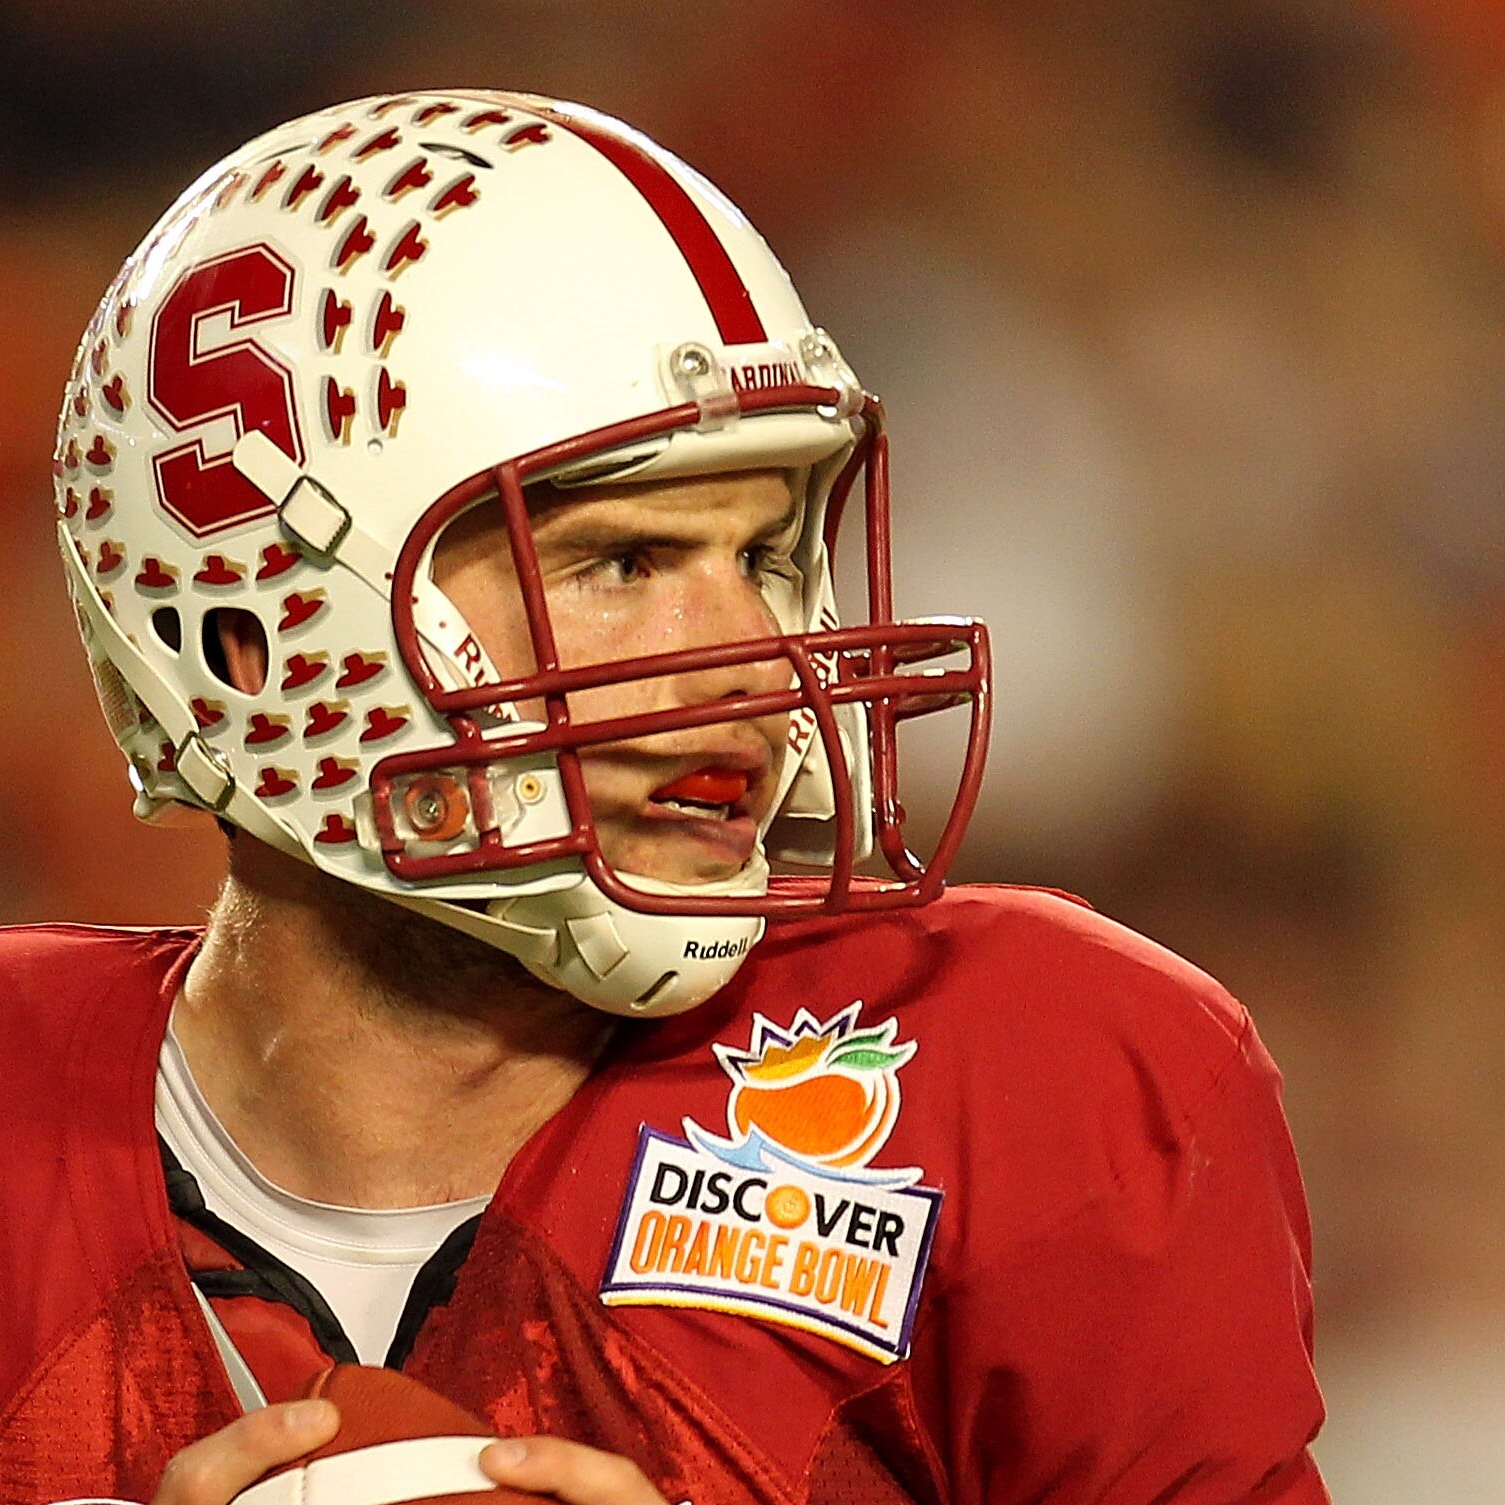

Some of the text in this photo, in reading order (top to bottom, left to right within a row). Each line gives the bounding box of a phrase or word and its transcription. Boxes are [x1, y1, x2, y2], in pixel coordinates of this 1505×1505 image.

[147, 242, 306, 538] S
[683, 936, 748, 960] Riddell
[650, 1162, 905, 1257] DISCOVER
[629, 1209, 892, 1330] ORANGE BOWL
